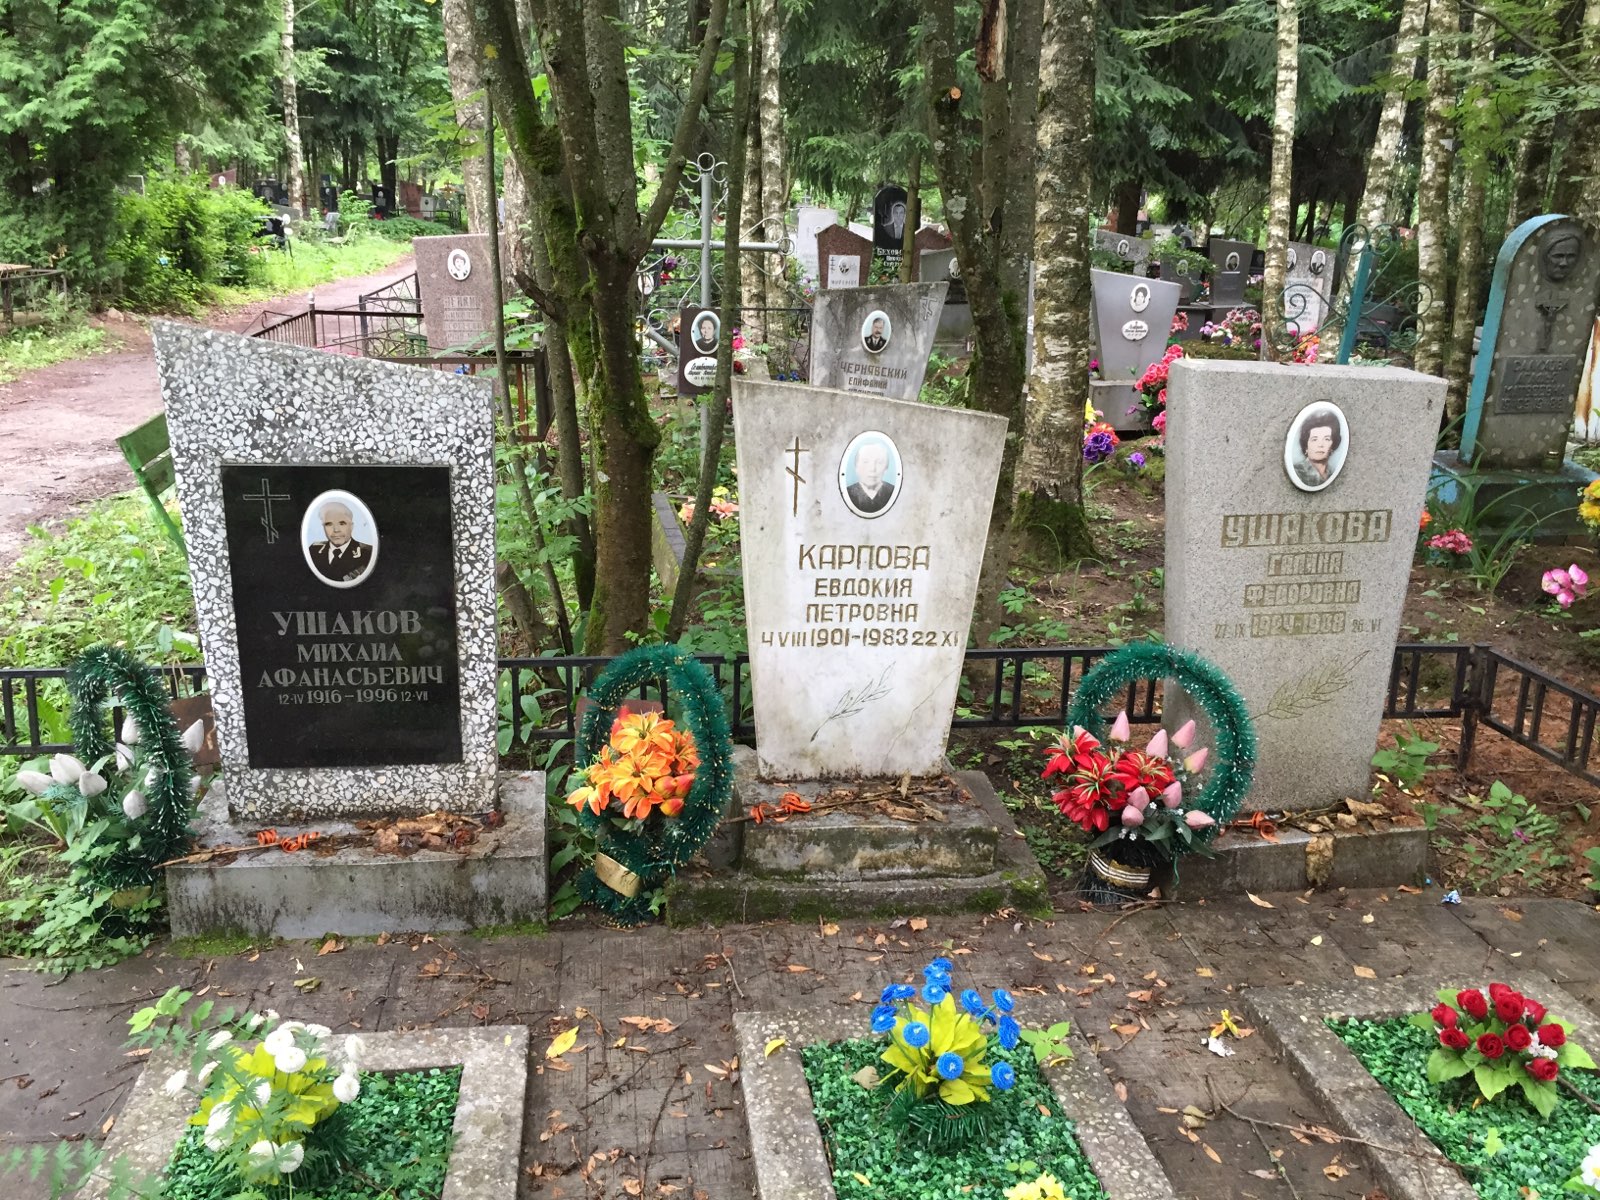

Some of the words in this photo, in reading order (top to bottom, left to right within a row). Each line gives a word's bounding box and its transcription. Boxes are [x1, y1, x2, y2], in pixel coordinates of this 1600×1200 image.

[840, 361, 908, 379] ЧЕРНЯВСКИЙ
[1223, 510, 1391, 547] УШАКОВА
[798, 544, 931, 570] КАРПОВА
[1268, 552, 1343, 576] ГАЛИНА
[814, 578, 913, 598] ЕВДОКИЯ
[1246, 581, 1360, 606] ФЕДОРОВНА
[271, 610, 422, 636] УШАКОВ
[806, 603, 919, 623] ПЕТРОВНА
[297, 642, 404, 663] МИХАИЛ
[257, 665, 443, 688] АФАНАСЬЕВИЧ
